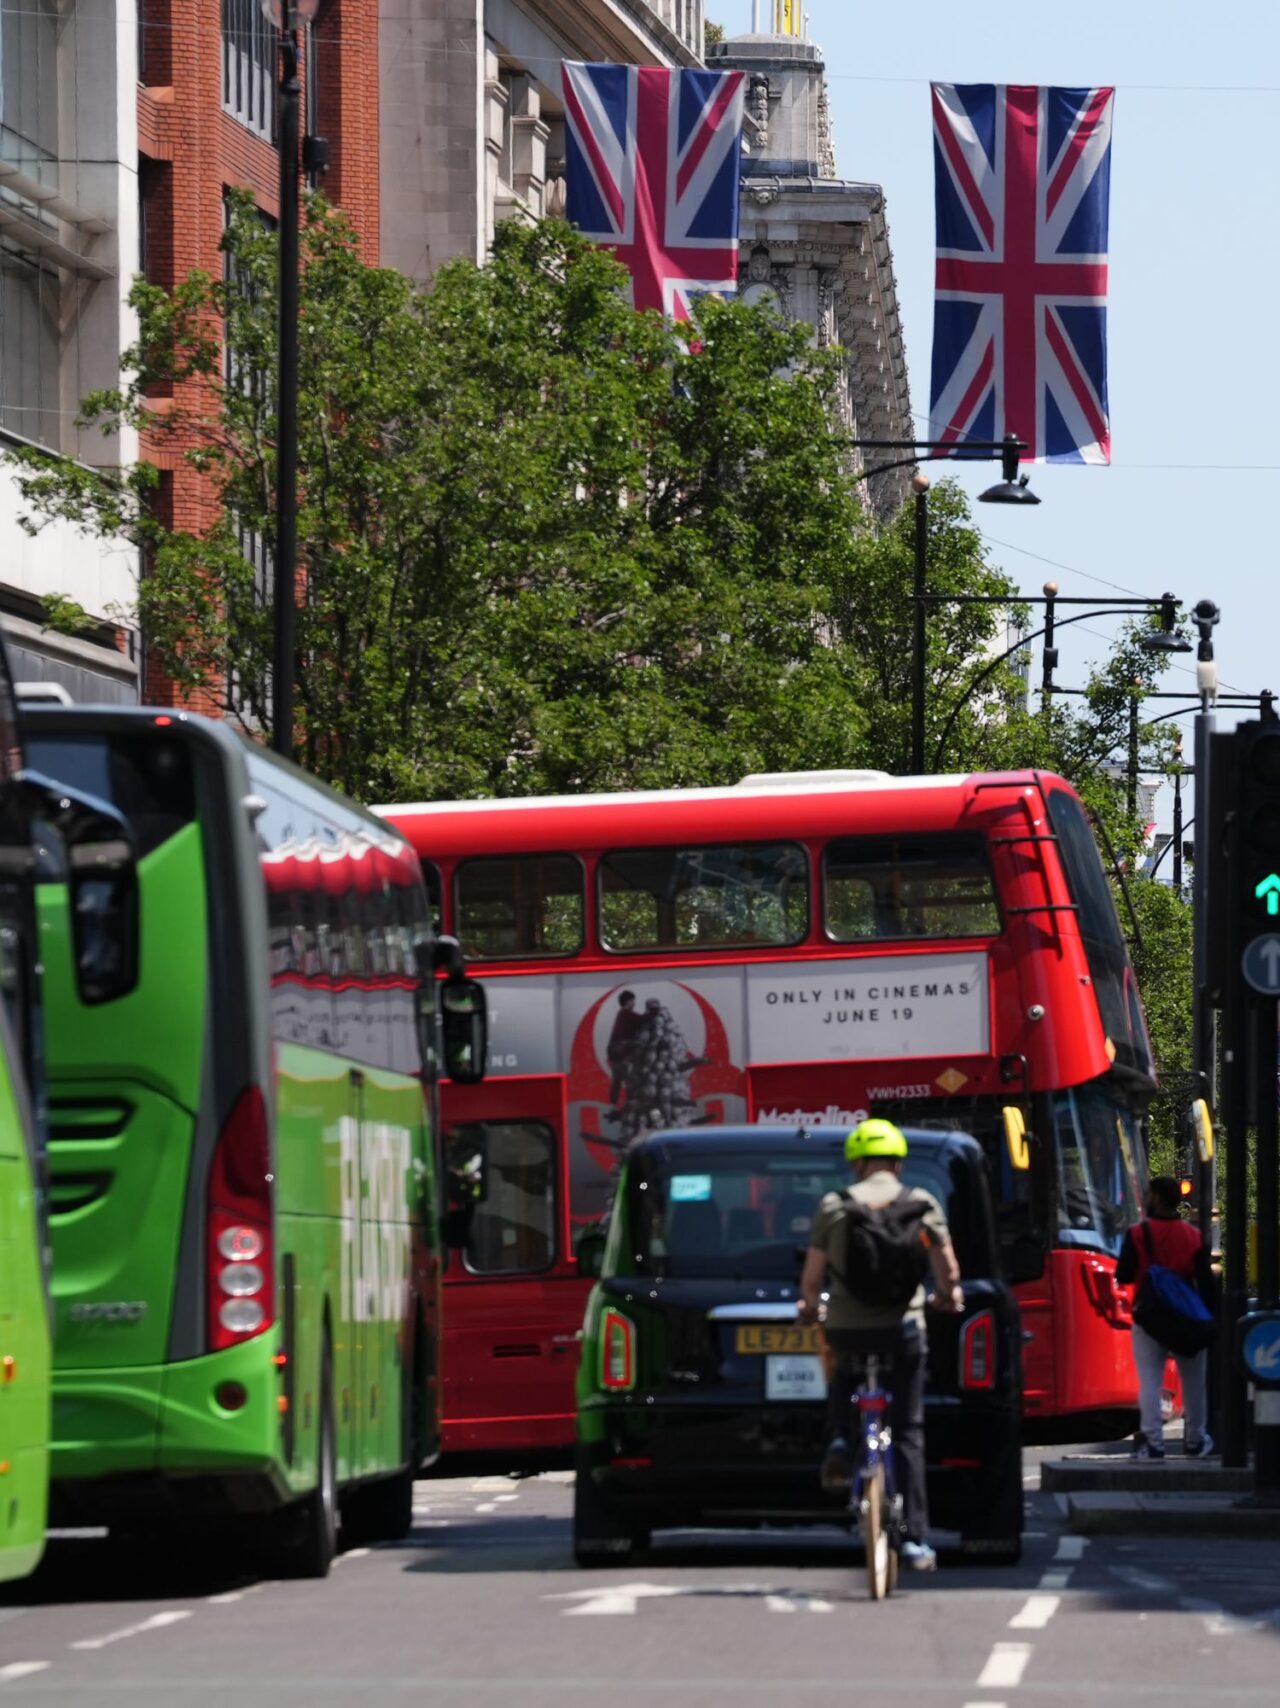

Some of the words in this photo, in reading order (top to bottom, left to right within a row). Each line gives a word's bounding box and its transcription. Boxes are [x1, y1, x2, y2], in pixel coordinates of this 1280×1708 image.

[766, 989, 823, 1005] ONLY
[834, 988, 856, 1001] IN
[868, 982, 970, 999] CINEMAS
[823, 1008, 880, 1024] JUNE
[892, 1007, 914, 1020] 19
[865, 1084, 931, 1099] VWH2333
[757, 1105, 869, 1126] Metroline
[744, 1327, 804, 1348] LE73
